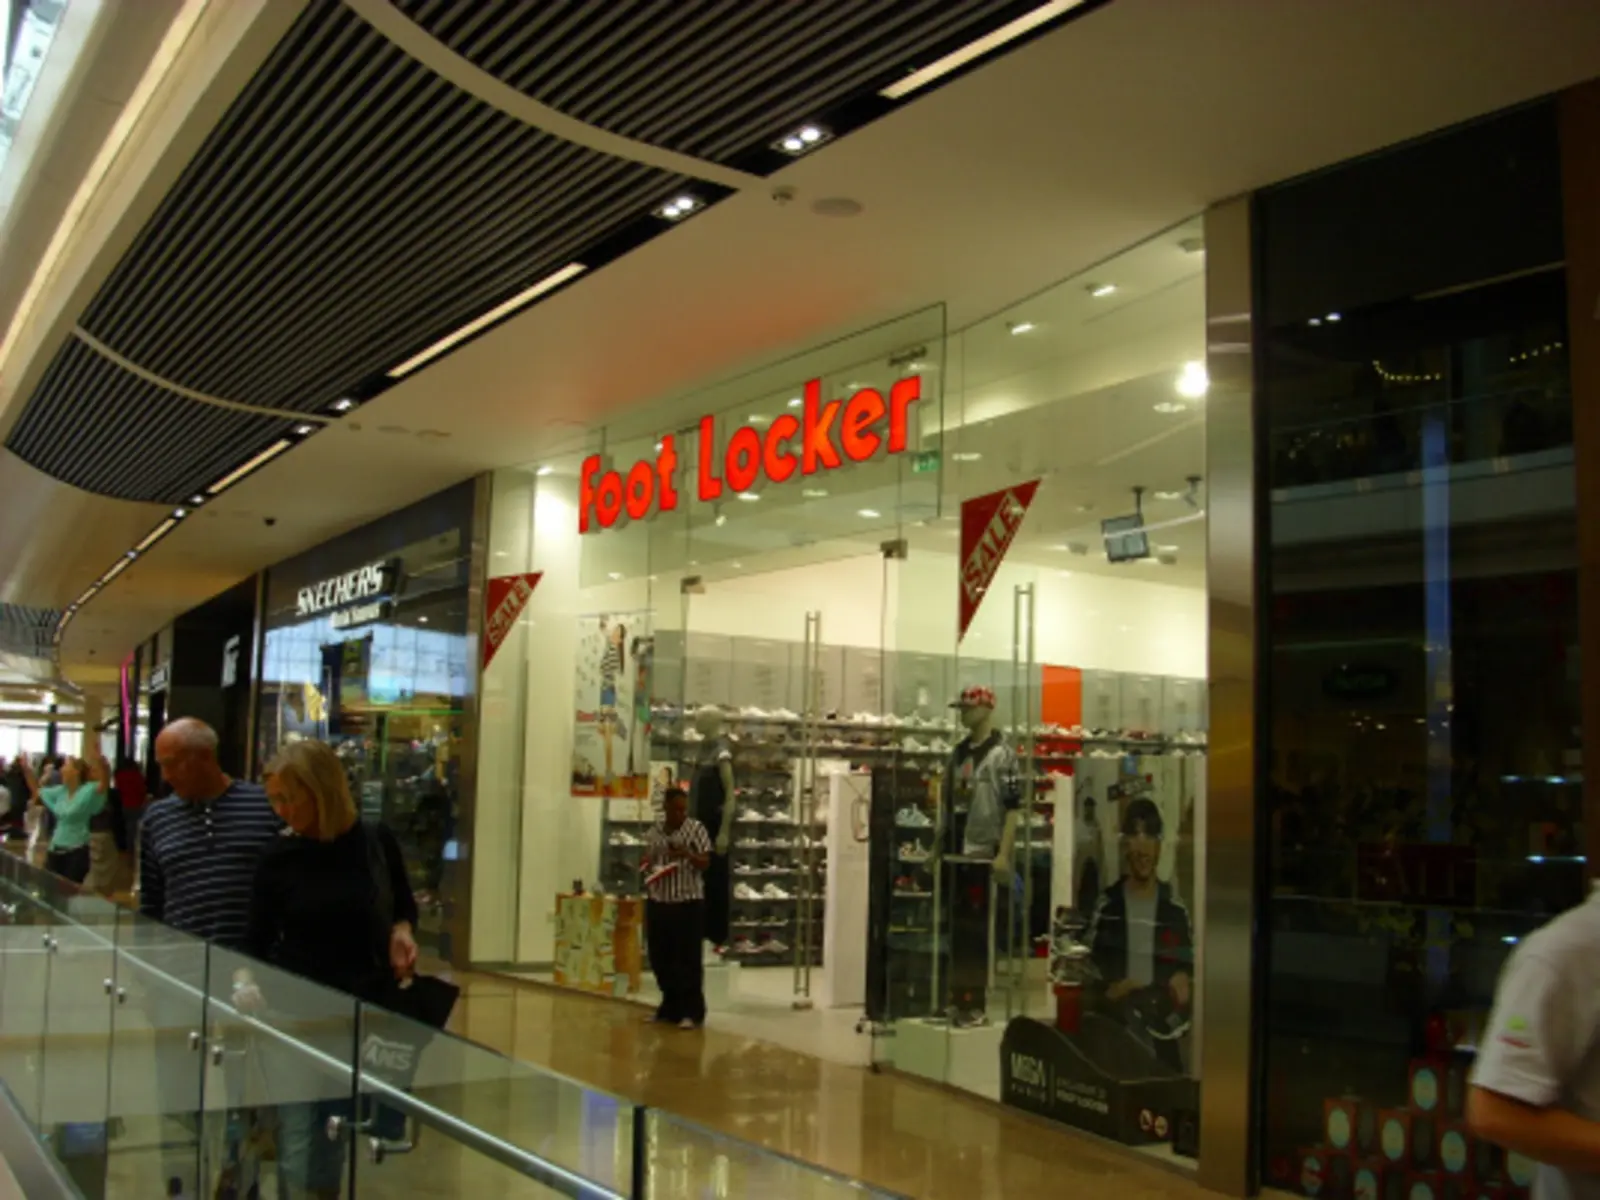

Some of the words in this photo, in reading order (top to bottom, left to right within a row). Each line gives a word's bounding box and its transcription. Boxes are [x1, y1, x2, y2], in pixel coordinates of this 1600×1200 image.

[578, 433, 678, 535] Foot
[698, 375, 921, 502] Locker
[295, 560, 386, 617] SKECHERS
[960, 489, 1027, 605] SALE
[486, 577, 535, 647] SALE
